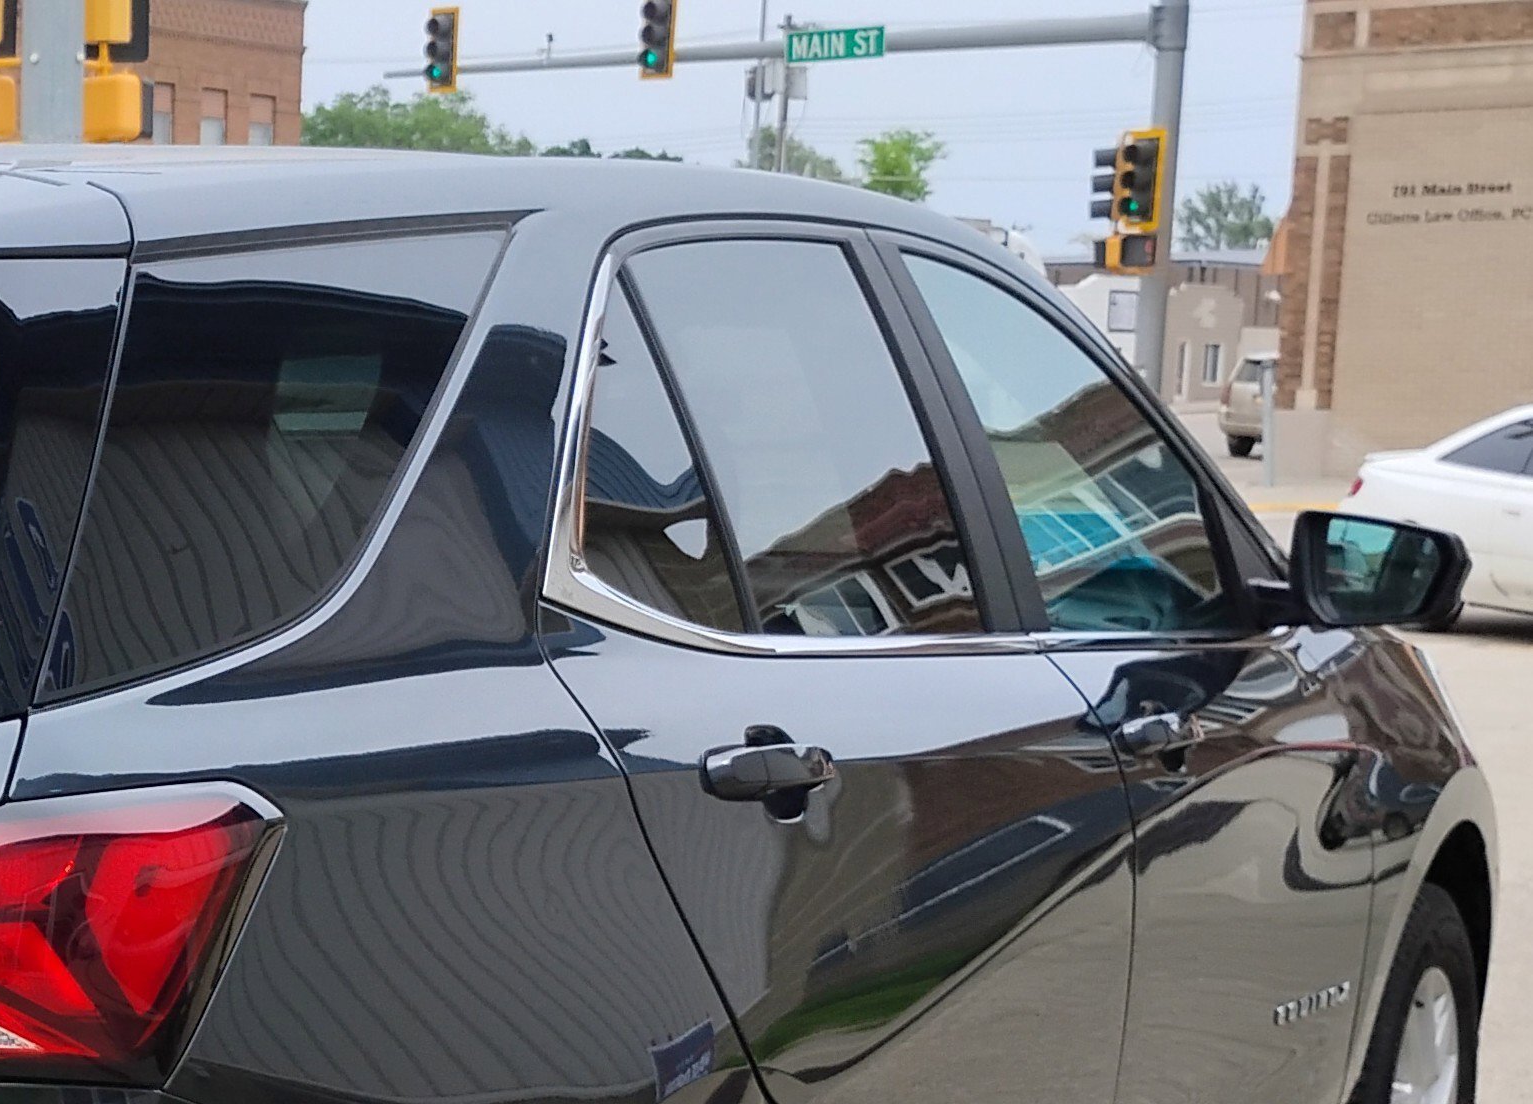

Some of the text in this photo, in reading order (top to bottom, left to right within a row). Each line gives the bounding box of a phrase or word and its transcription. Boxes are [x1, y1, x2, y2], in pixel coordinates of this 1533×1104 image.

[792, 29, 880, 60] MAIN ST
[1421, 183, 1463, 197] Main
[1467, 181, 1513, 195] Street
